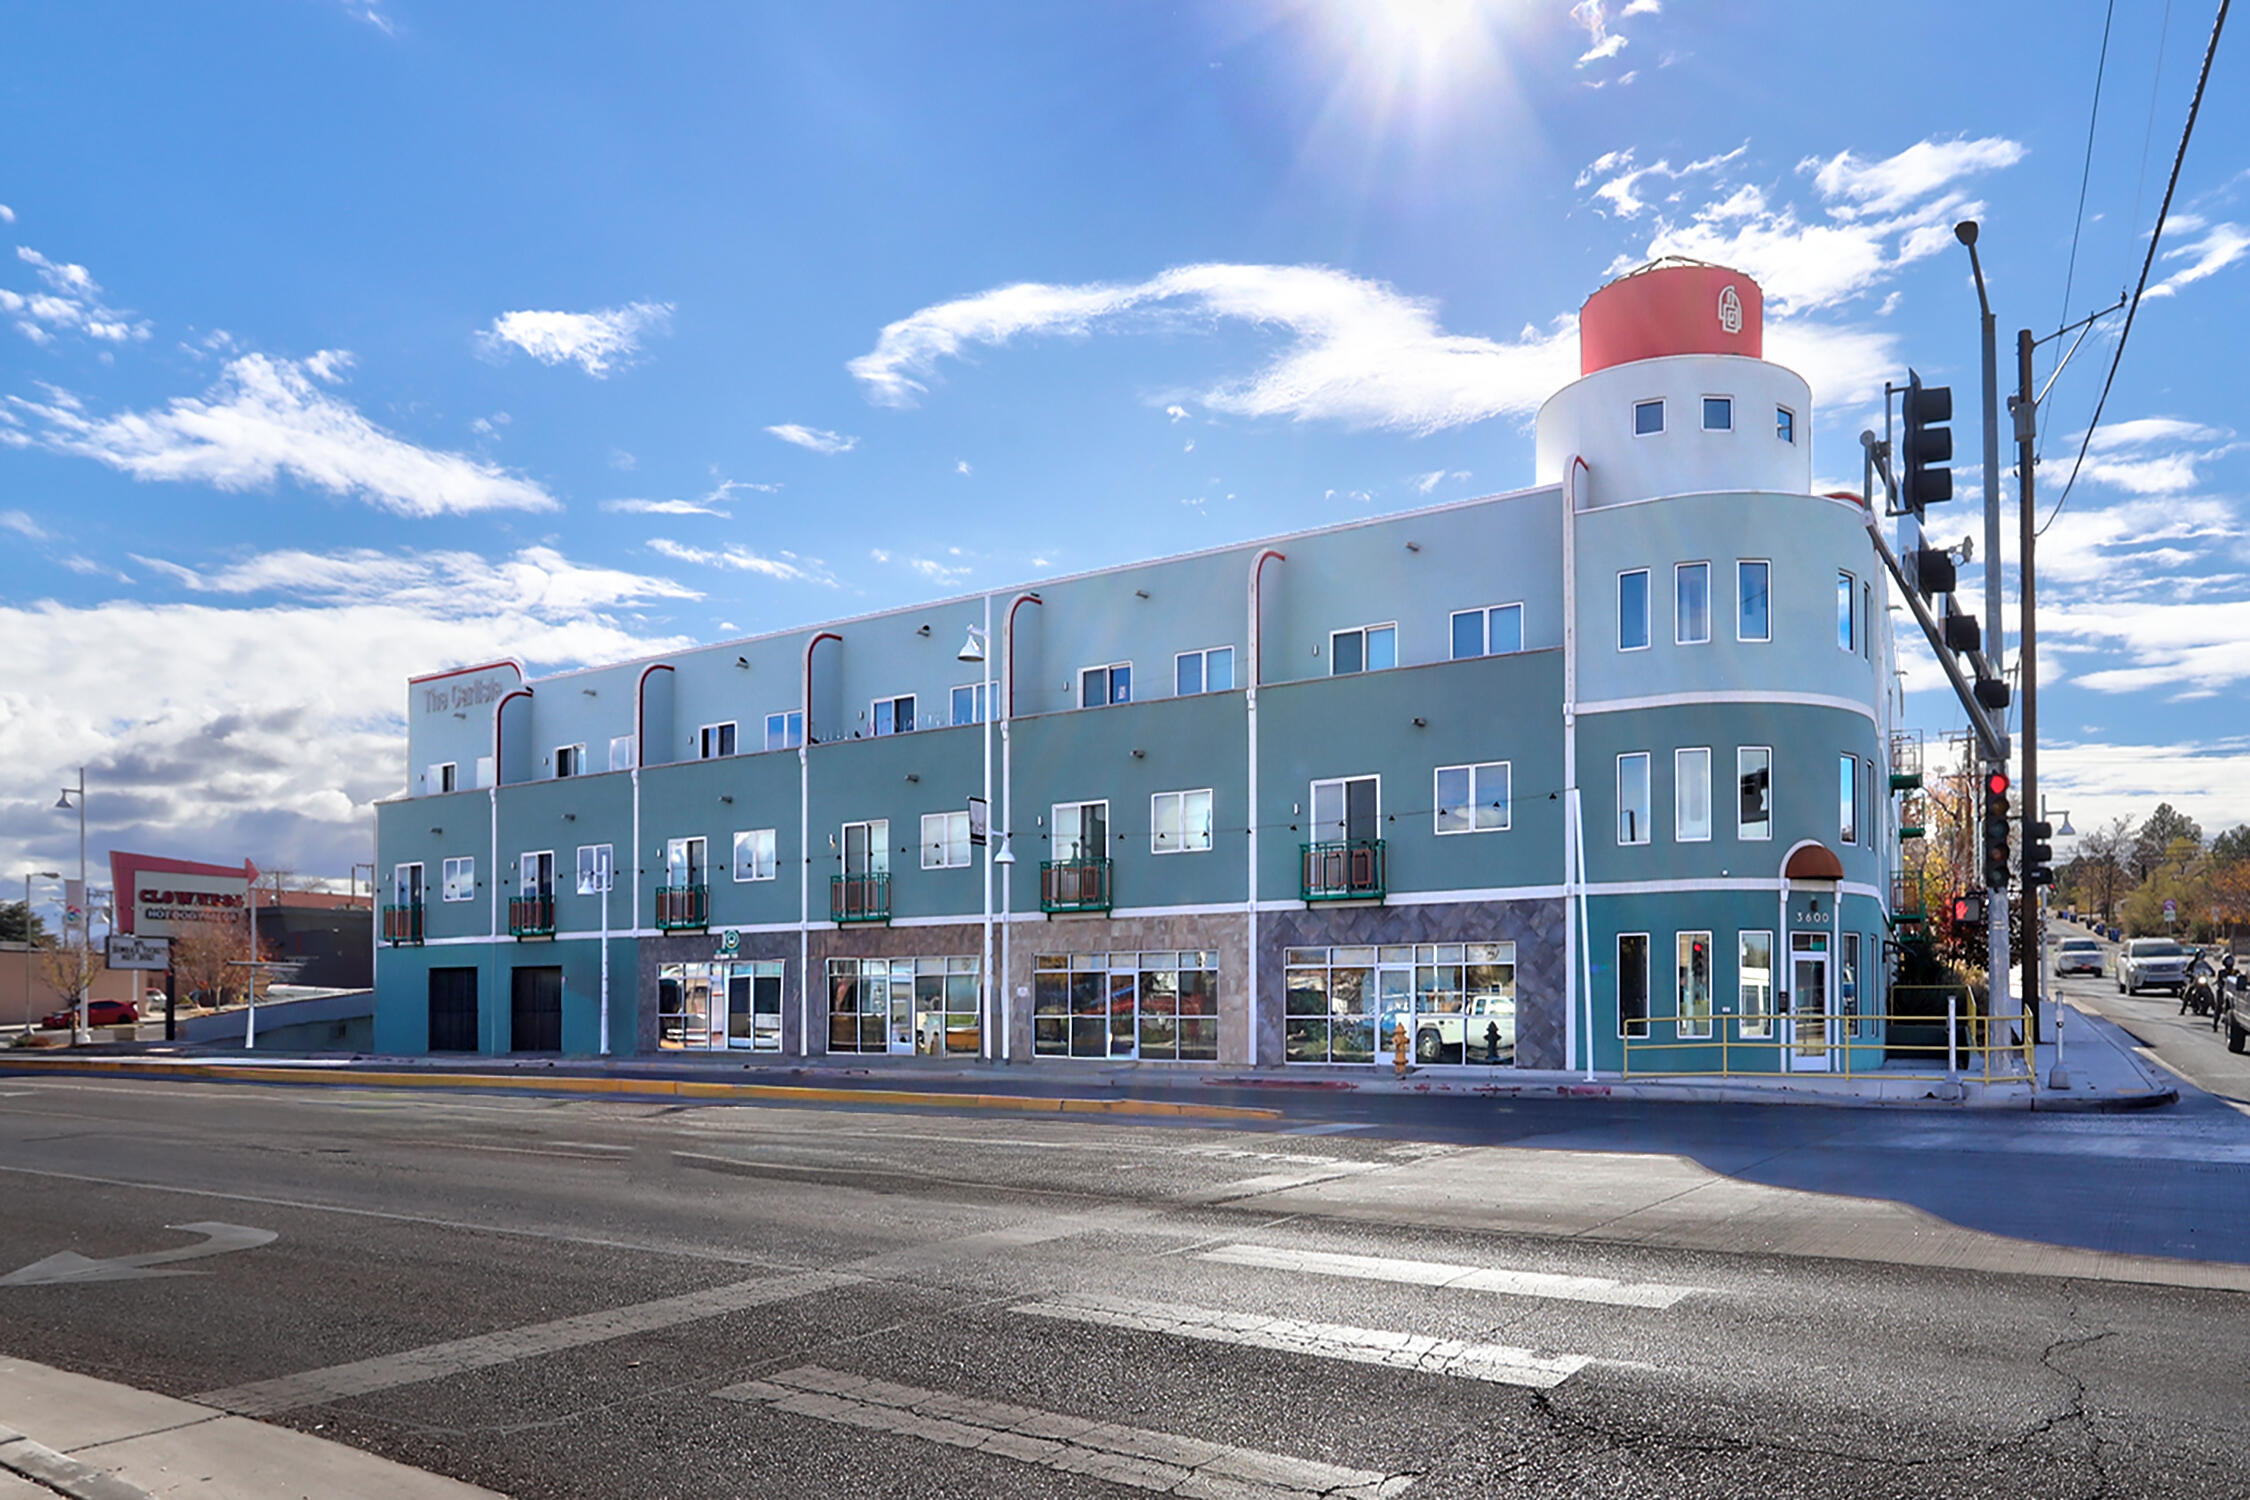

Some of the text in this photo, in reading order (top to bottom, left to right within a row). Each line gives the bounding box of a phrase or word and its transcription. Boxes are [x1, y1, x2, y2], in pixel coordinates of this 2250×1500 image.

[424, 688, 448, 713] The
[146, 908, 169, 920] HOT
[1796, 912, 1830, 923] 3600
